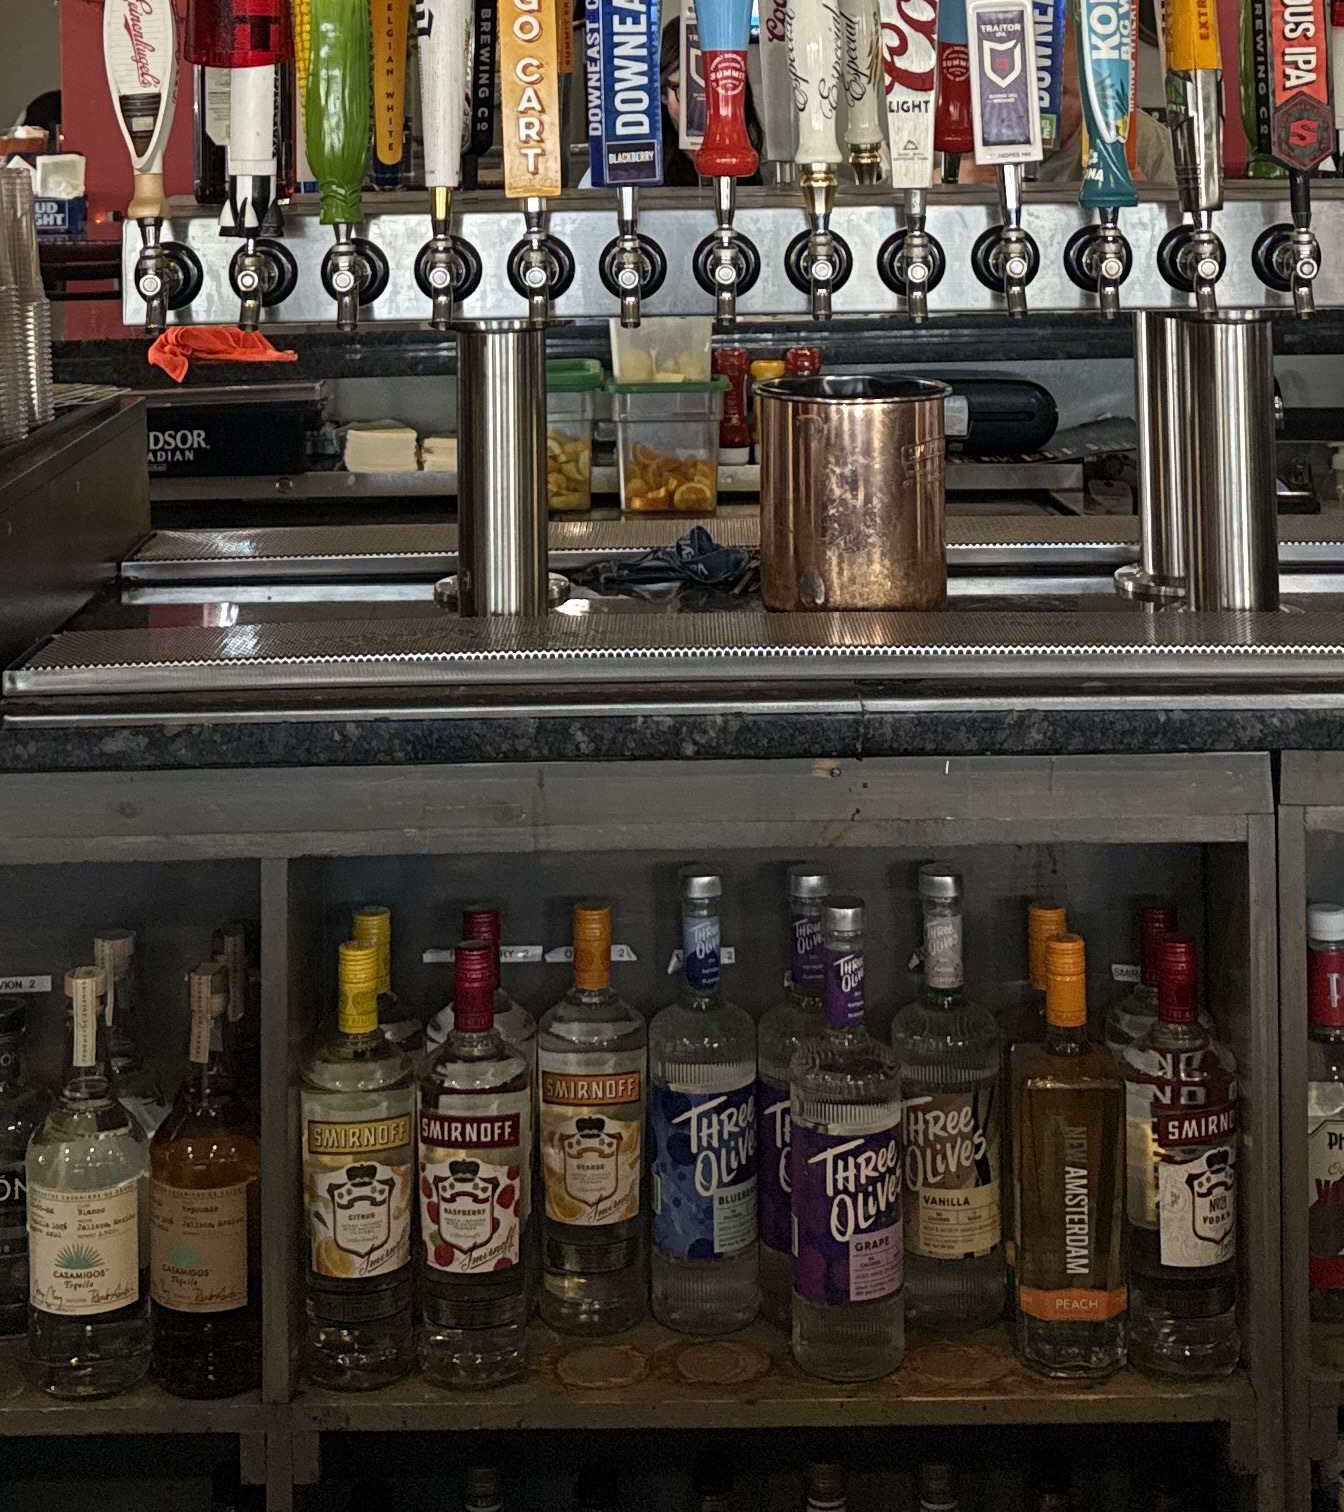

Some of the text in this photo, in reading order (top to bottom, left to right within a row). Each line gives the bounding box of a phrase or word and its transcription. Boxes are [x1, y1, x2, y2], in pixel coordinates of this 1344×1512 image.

[980, 23, 1021, 34] TRAITOR
[1119, 19, 1133, 62] BIG
[478, 7, 493, 100] BREWING
[586, 21, 604, 137] DOWNEAST
[1284, 47, 1317, 90] IPA
[514, 57, 545, 175] CART
[887, 98, 931, 115] LIGHT
[385, 90, 394, 152] WHITE
[608, 151, 655, 166] BLACKBERRY
[544, 1076, 639, 1101] SMIRNOFF
[313, 1124, 408, 1149] SMIRNOFF
[421, 1119, 514, 1144] SMIRNOFF
[923, 1195, 971, 1208] VANILLA
[1064, 1166, 1090, 1275] AMSTERDAM
[854, 1235, 891, 1253] GRAPE
[53, 1269, 106, 1280] CASAMIGOS
[1055, 1297, 1099, 1311] PEACH
